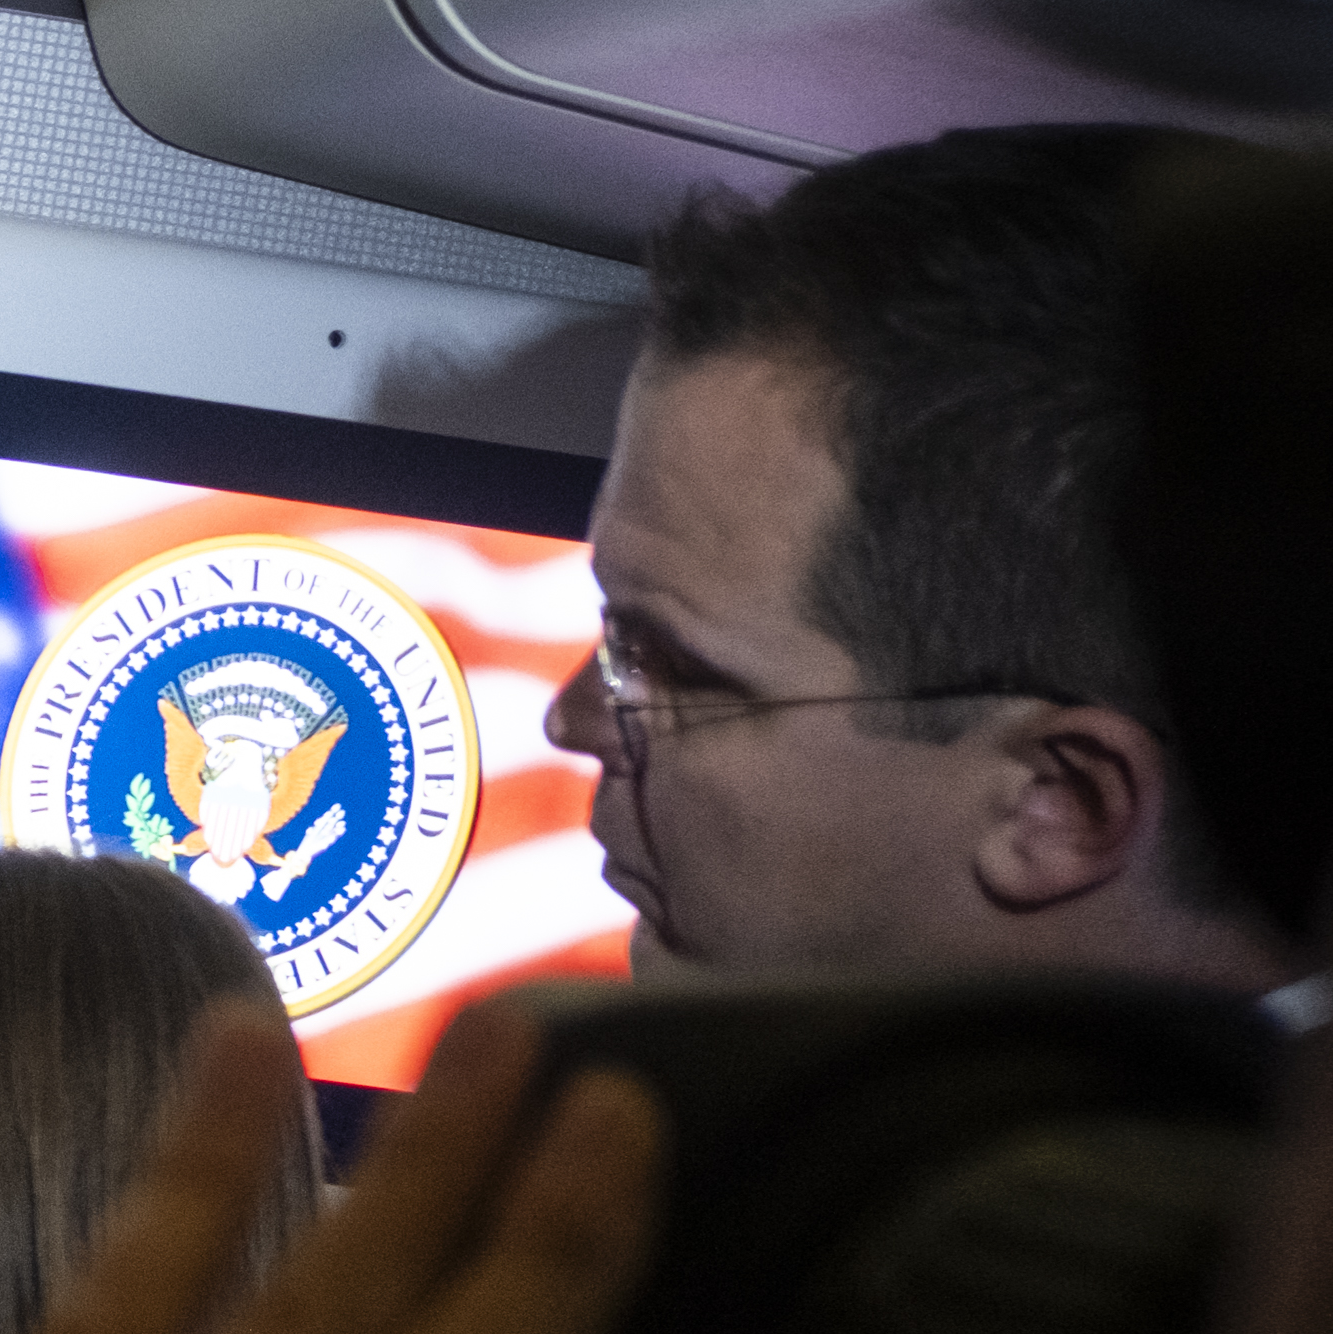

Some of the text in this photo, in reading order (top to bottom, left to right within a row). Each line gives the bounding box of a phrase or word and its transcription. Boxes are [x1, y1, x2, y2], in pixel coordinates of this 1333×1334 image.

[283, 567, 327, 596] OF
[338, 586, 393, 639] THE
[34, 558, 271, 741] PRESIDENT
[393, 642, 455, 838] UNITED
[273, 877, 414, 995] STATE
